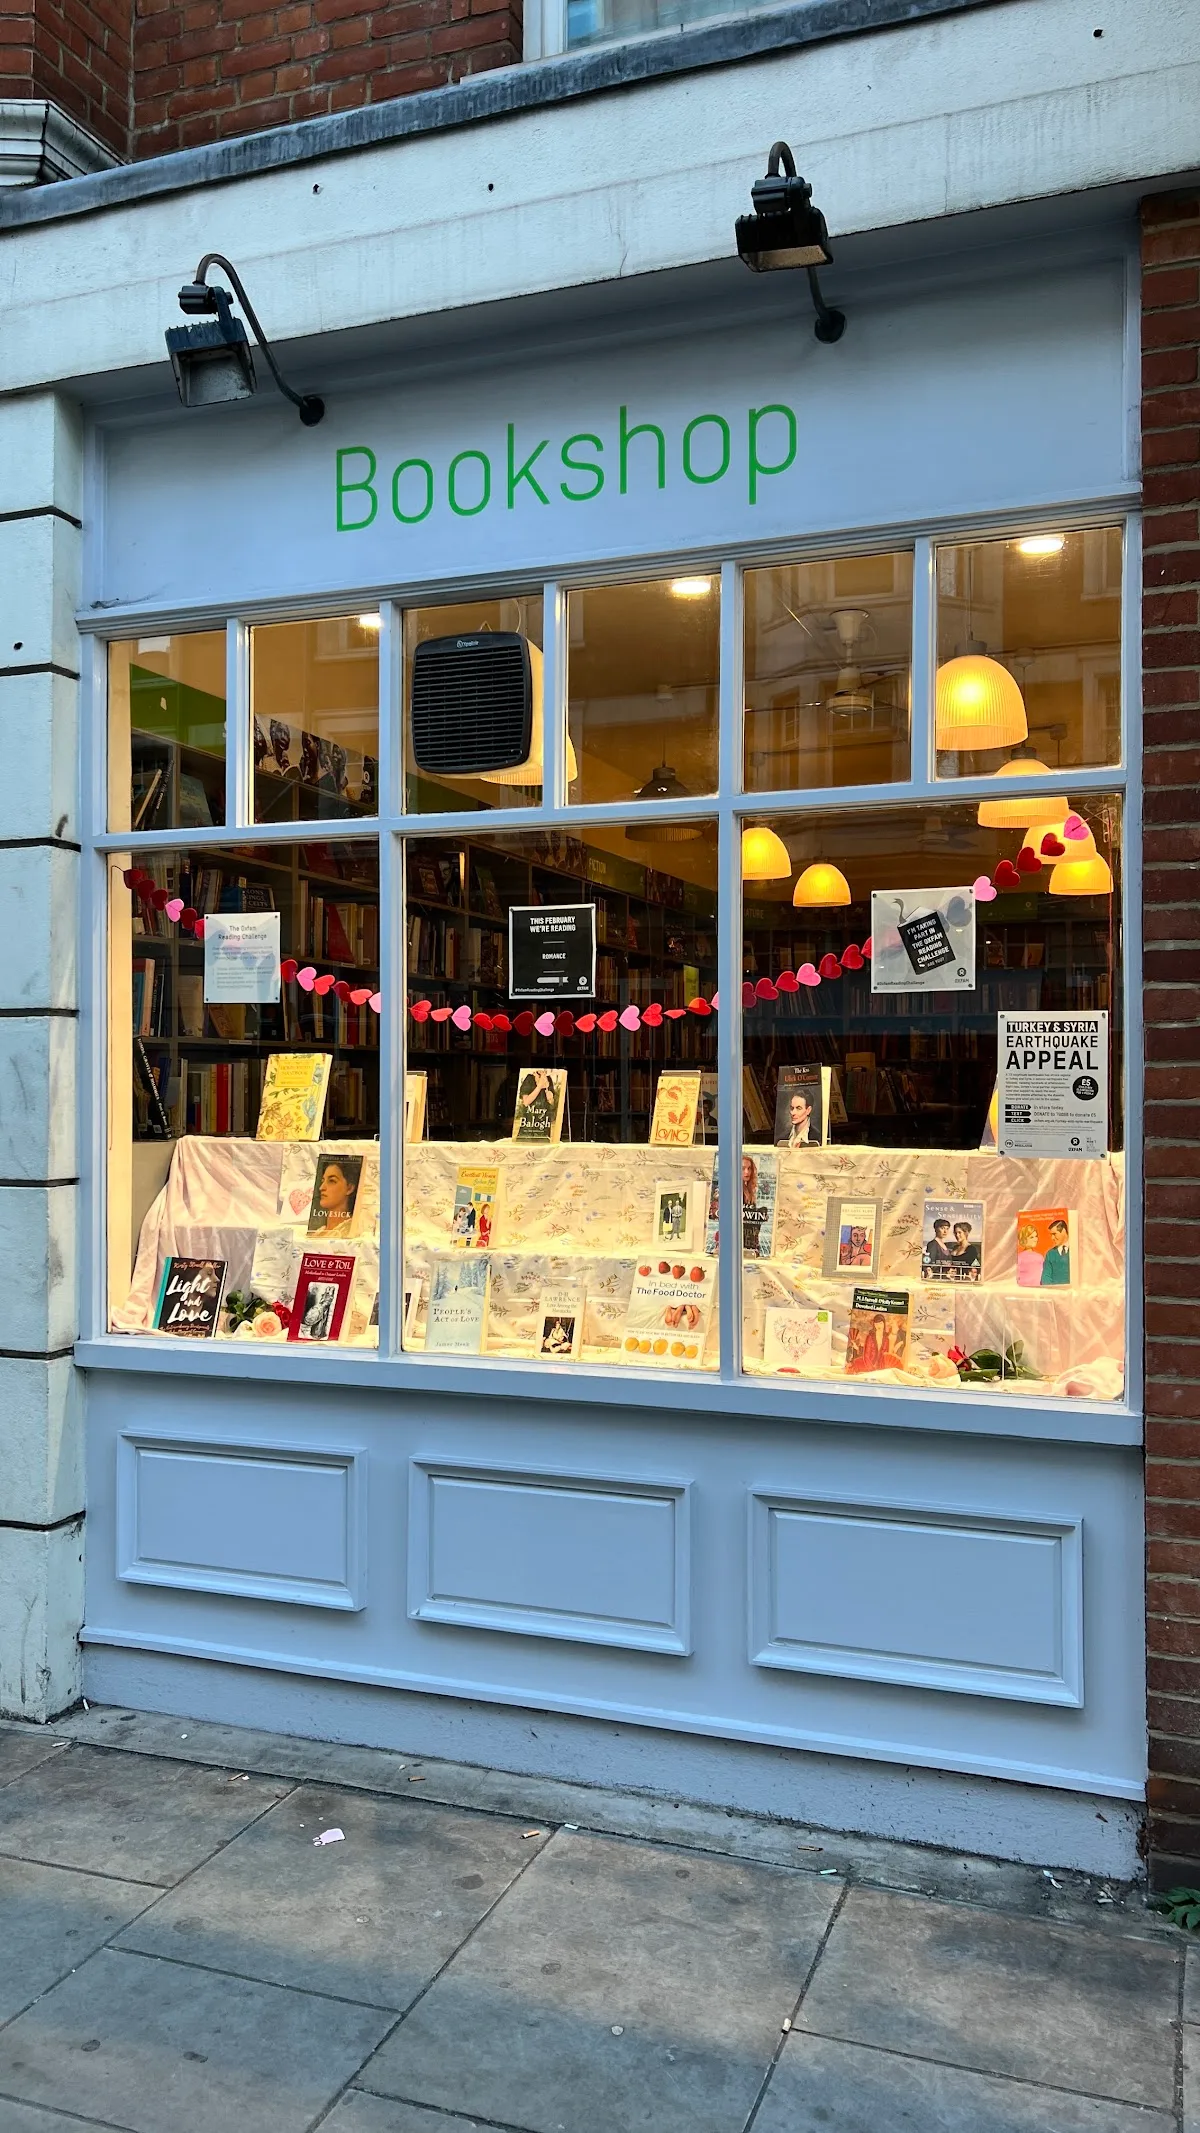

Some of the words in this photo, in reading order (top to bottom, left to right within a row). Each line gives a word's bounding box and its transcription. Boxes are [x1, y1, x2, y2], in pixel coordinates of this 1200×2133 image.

[336, 403, 798, 532] Bookshop
[530, 917, 545, 925] THIS
[545, 916, 576, 924] FEBRUARY
[916, 919, 937, 931] TAKING
[550, 924, 576, 932] READING
[242, 933, 267, 941] Challenge
[911, 941, 924, 949] THE
[923, 932, 944, 945] OXFAM
[914, 930, 928, 940] PART
[917, 946, 950, 963] CHALLENGE
[918, 941, 943, 955] READING
[1008, 1022, 1051, 1032] TURKEY
[1052, 1022, 1061, 1032] &
[1063, 1022, 1097, 1032] SYRIA
[1006, 1035, 1098, 1049] EARTHQUAKE
[1006, 1051, 1098, 1070] APPEAL
[526, 1105, 548, 1119] Mary
[520, 1116, 551, 1130] Balogh
[655, 1120, 690, 1142] LOVING
[313, 1209, 352, 1219] LOVESICK
[304, 1258, 327, 1269] LOVE
[327, 1260, 335, 1269] &
[335, 1260, 352, 1270] TOIL
[166, 1275, 211, 1302] Light
[636, 1287, 652, 1295] The
[653, 1289, 675, 1297] Food
[676, 1290, 706, 1298] Doctor
[680, 1282, 699, 1290] with
[184, 1296, 202, 1307] and
[167, 1303, 213, 1324] Love
